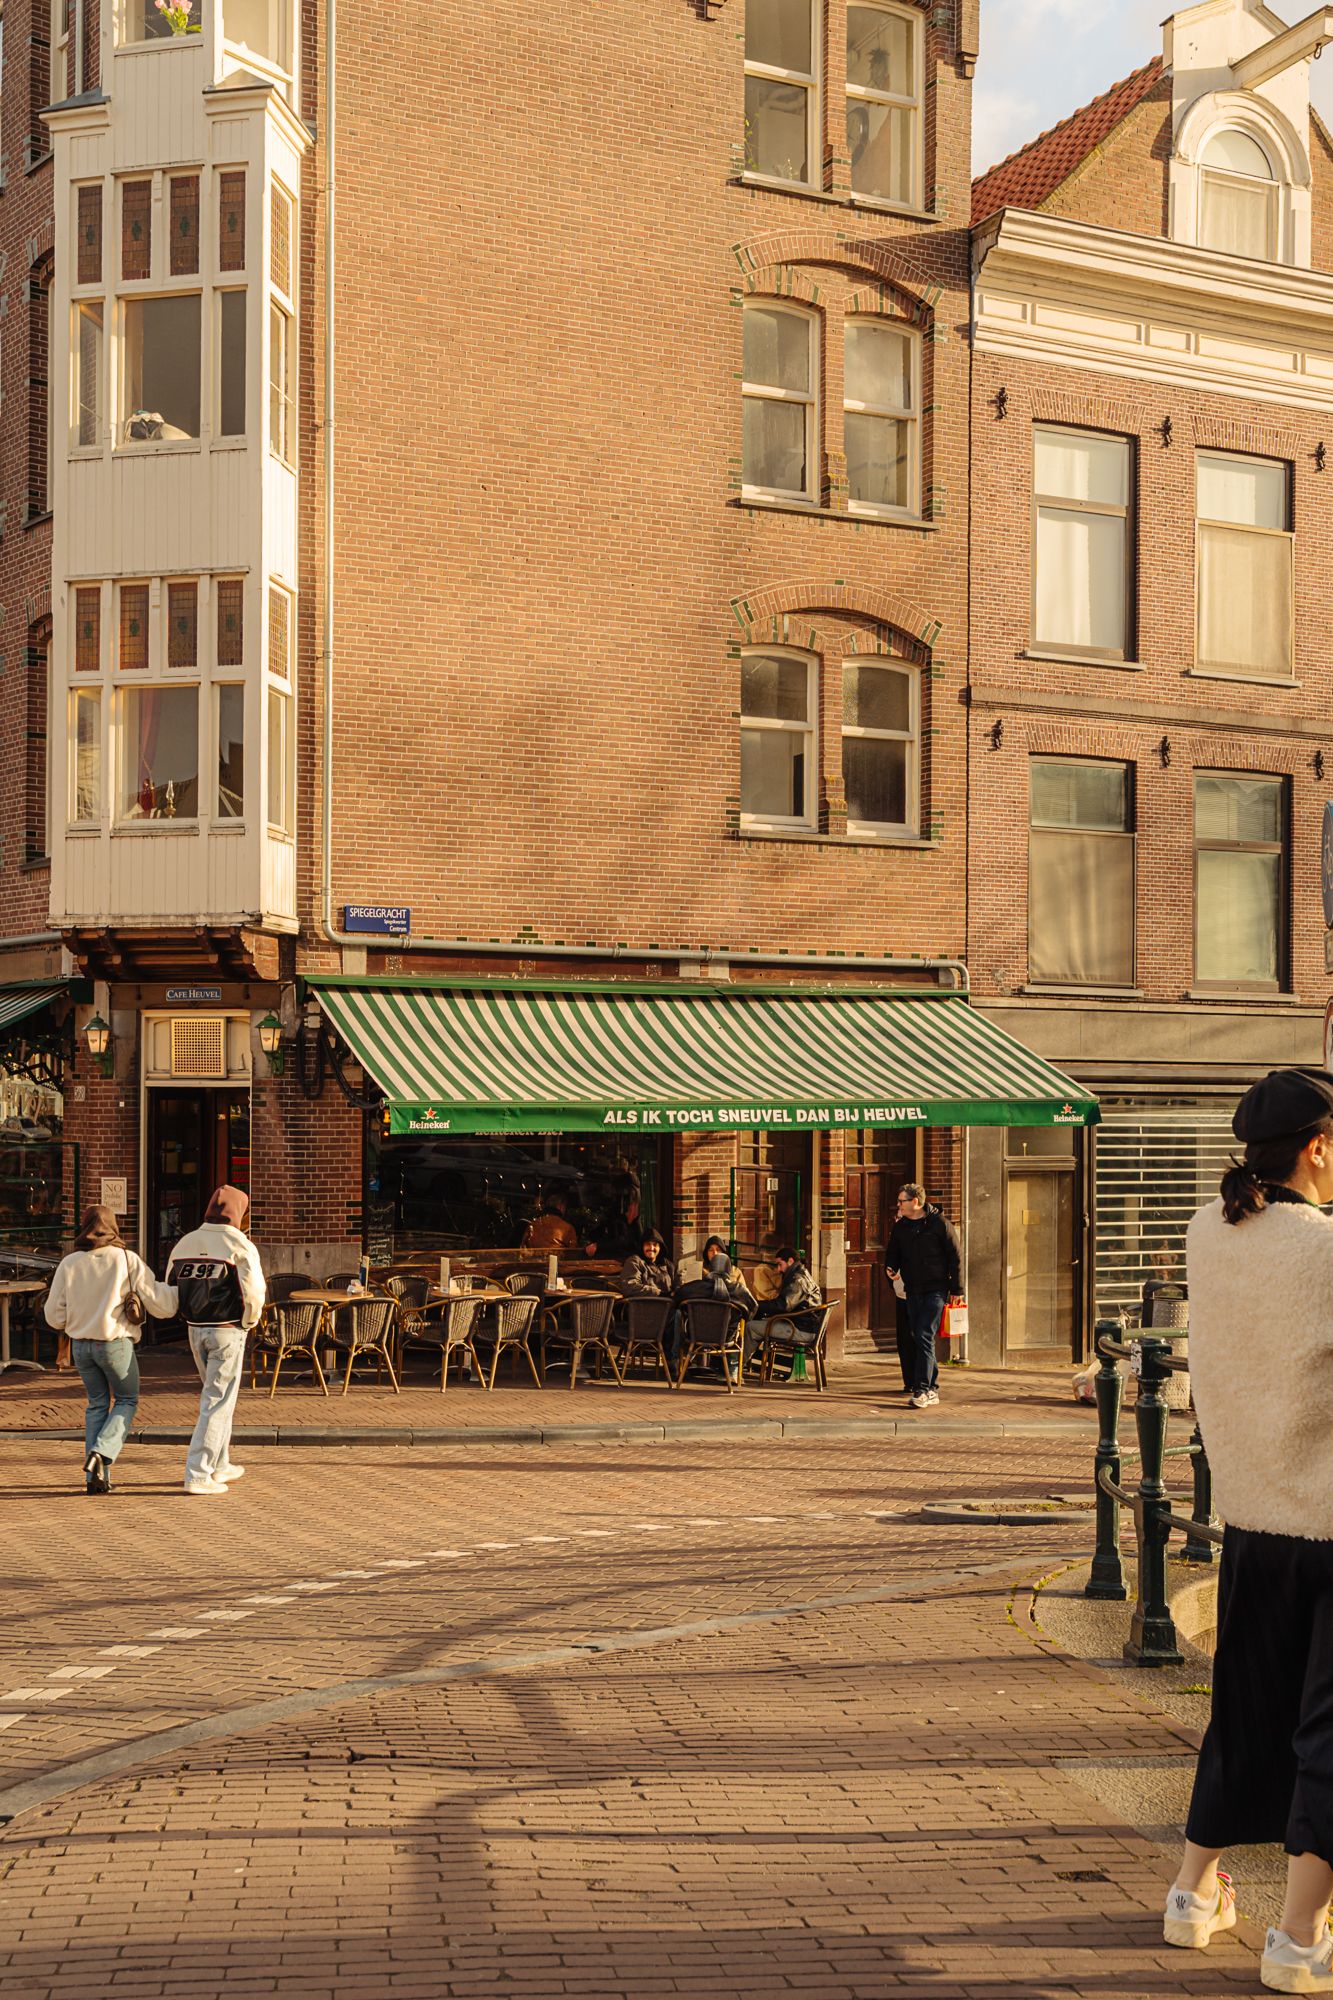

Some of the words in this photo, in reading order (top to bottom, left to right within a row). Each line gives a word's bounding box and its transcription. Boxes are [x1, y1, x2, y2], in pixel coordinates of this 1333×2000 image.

[349, 907, 407, 918] SPIEGELGRACHT
[603, 1110, 638, 1124] ALS
[642, 1110, 662, 1124] IK
[665, 1109, 715, 1124] TOCH
[718, 1109, 792, 1123] SNEUVEL
[795, 1108, 830, 1122] DAN
[833, 1108, 860, 1122] BIJ
[863, 1107, 928, 1121] HEUVEL
[1053, 1114, 1084, 1123] Heineken
[409, 1120, 450, 1129] Heineken
[105, 1183, 123, 1193] NO
[179, 1263, 195, 1278] B
